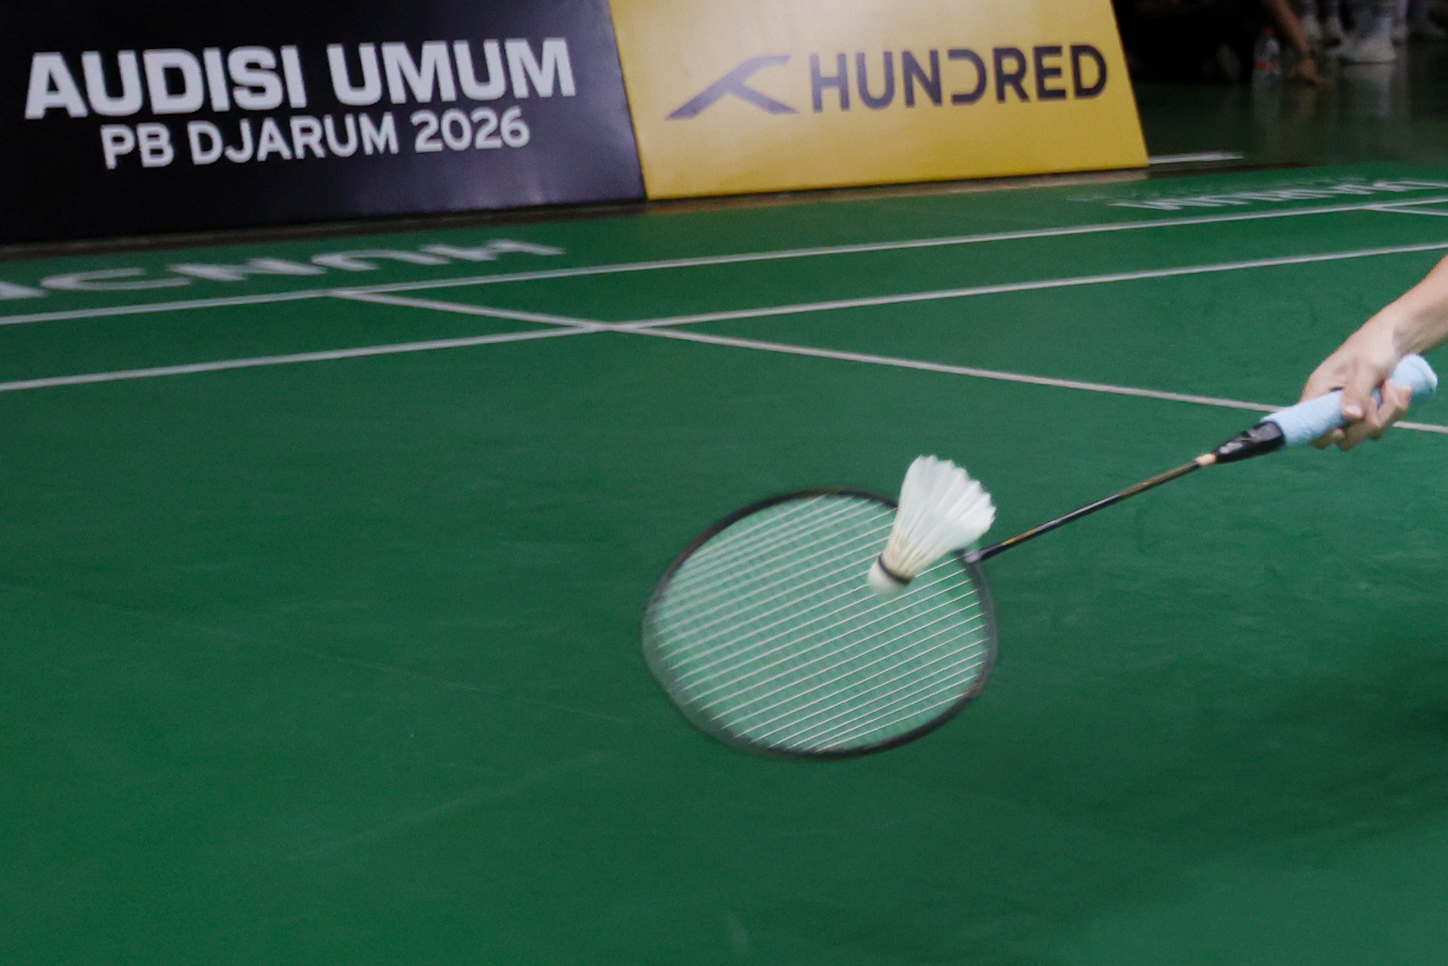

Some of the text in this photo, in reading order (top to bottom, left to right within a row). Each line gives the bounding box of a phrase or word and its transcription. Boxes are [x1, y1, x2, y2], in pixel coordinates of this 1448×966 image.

[25, 37, 576, 119] AUDISI UMUM
[809, 43, 1108, 113] HUNDRED
[101, 107, 531, 169] PB DJARUM 2026
